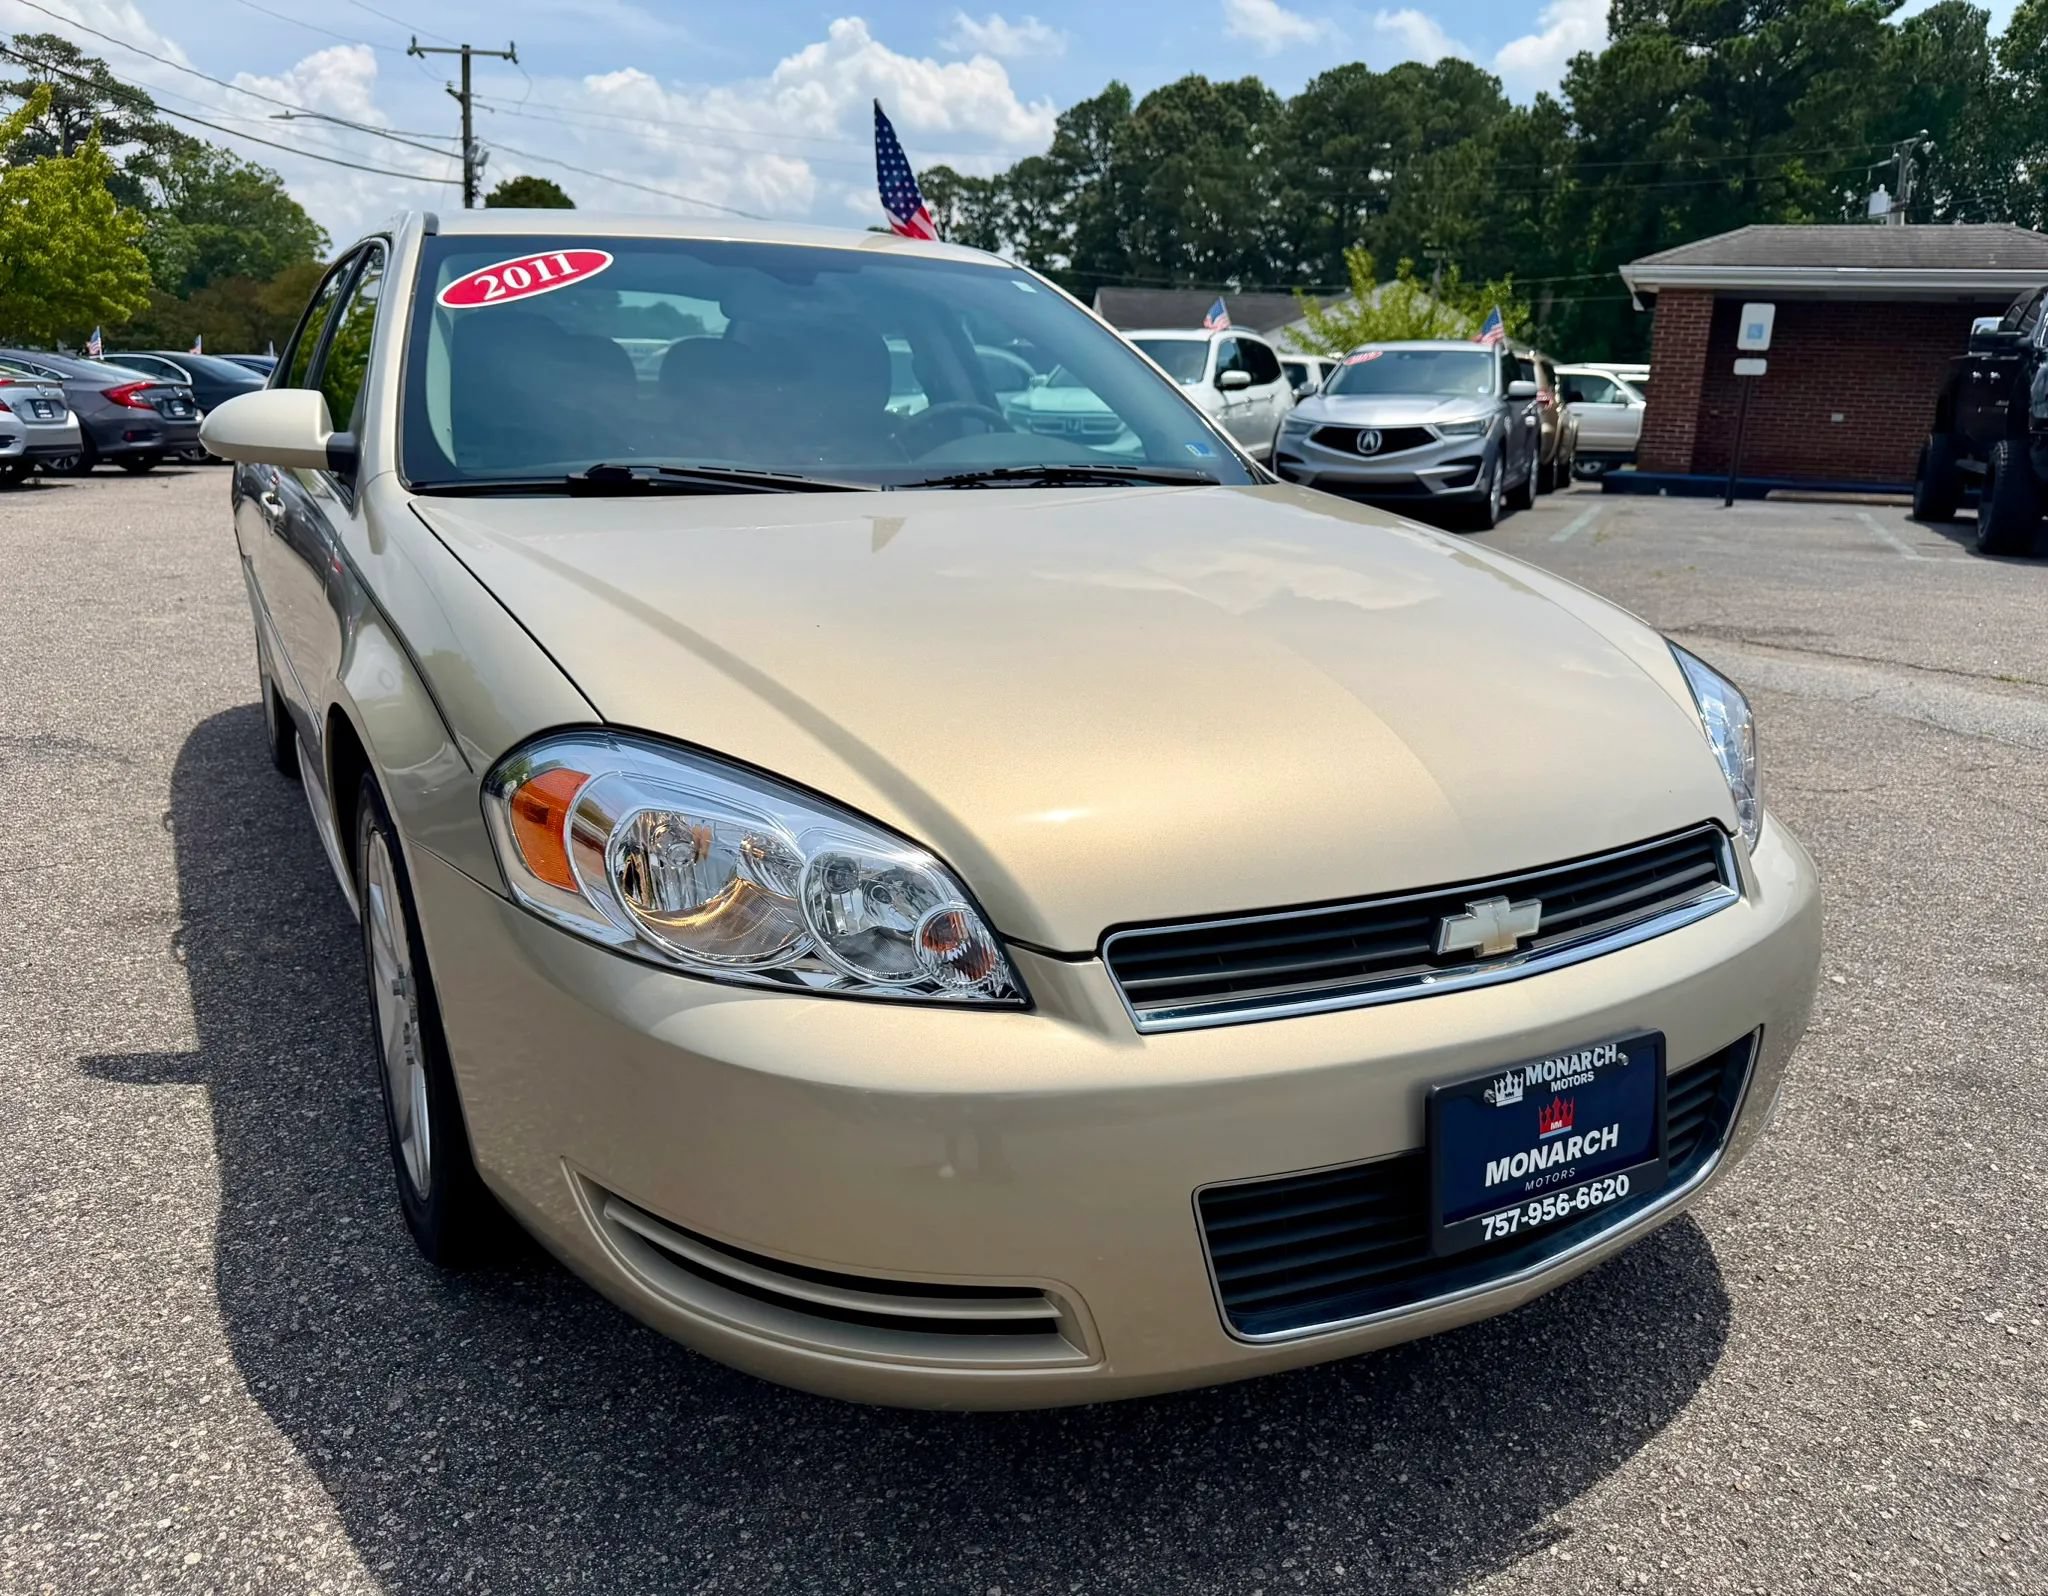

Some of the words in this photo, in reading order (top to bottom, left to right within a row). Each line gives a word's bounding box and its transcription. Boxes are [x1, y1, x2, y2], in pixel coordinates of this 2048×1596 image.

[474, 253, 579, 301] 2011
[1525, 1044, 1617, 1087] MONARCH
[1551, 1071, 1595, 1093] MOTORS
[1484, 1123, 1619, 1187] MONARCH
[1524, 1167, 1576, 1192] MOTORS
[1481, 1174, 1630, 1241] 757-956-6620
